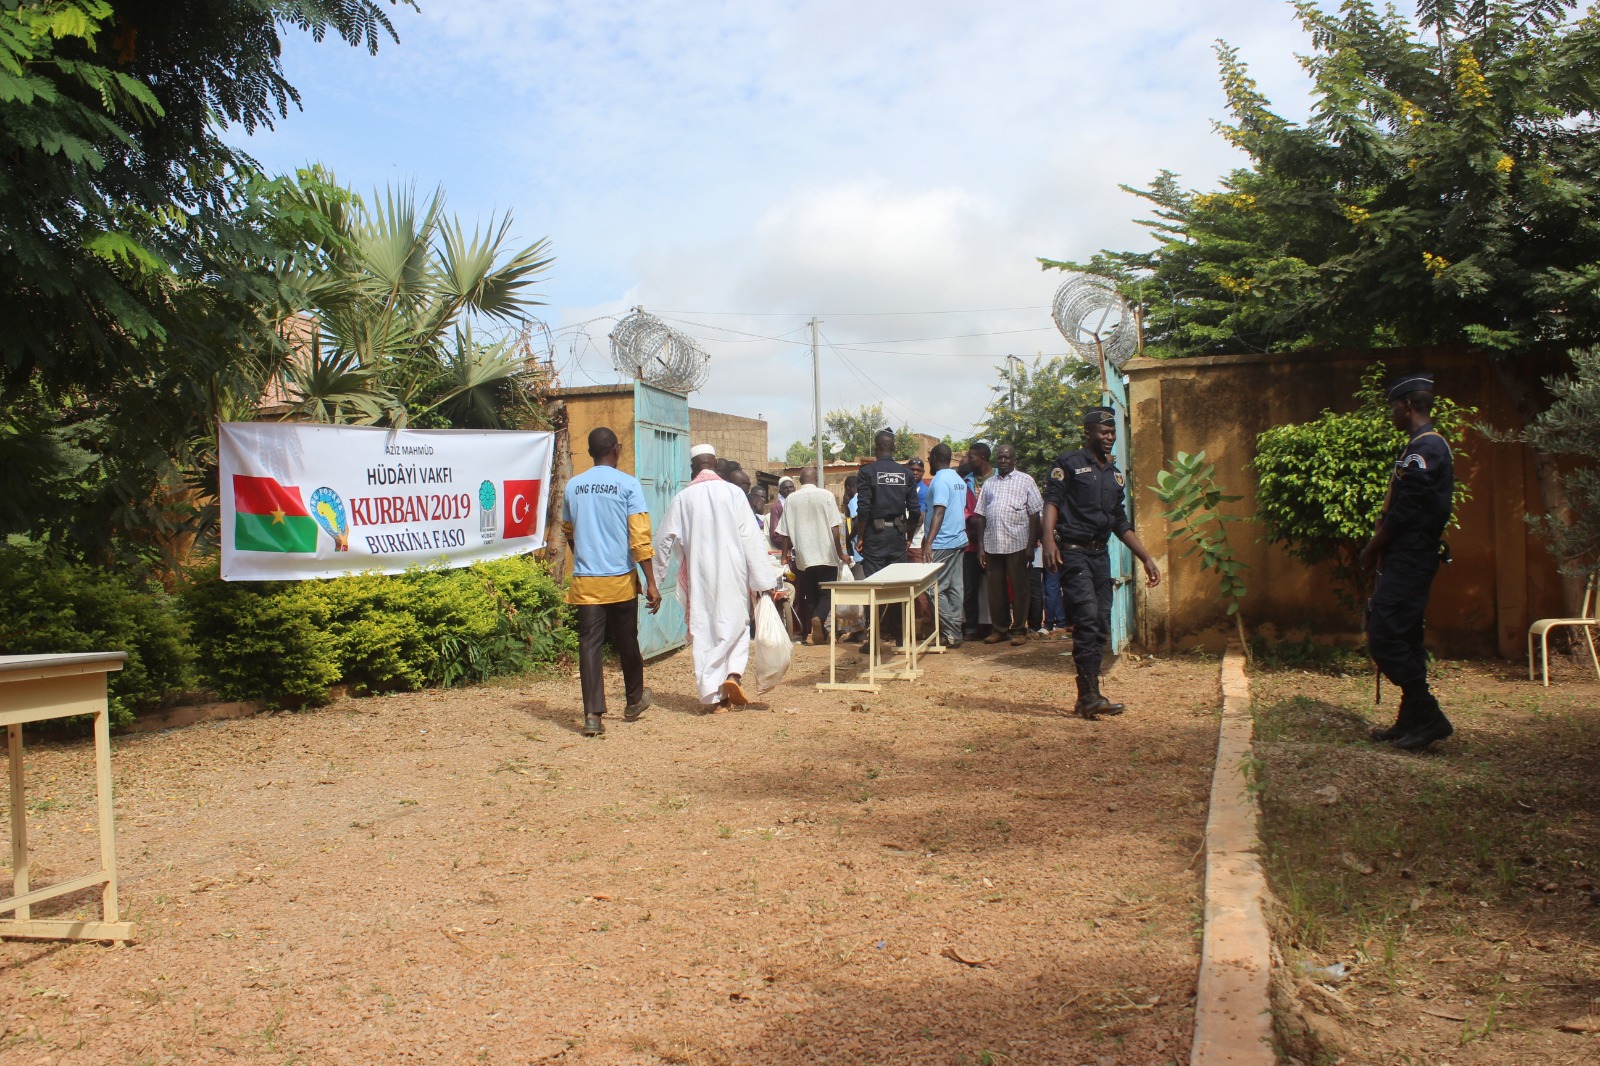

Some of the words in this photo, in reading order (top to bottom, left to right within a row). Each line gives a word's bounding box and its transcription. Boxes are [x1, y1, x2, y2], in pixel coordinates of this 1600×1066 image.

[367, 463, 417, 485] HÜDÂYİ
[419, 467, 453, 484] VAKFI
[575, 484, 589, 495] ONG
[591, 484, 617, 495] FOSAPA
[349, 495, 429, 526] KURBAN
[431, 493, 471, 521] 2019
[365, 528, 432, 555] BURKİNA
[432, 528, 466, 549] FASO
